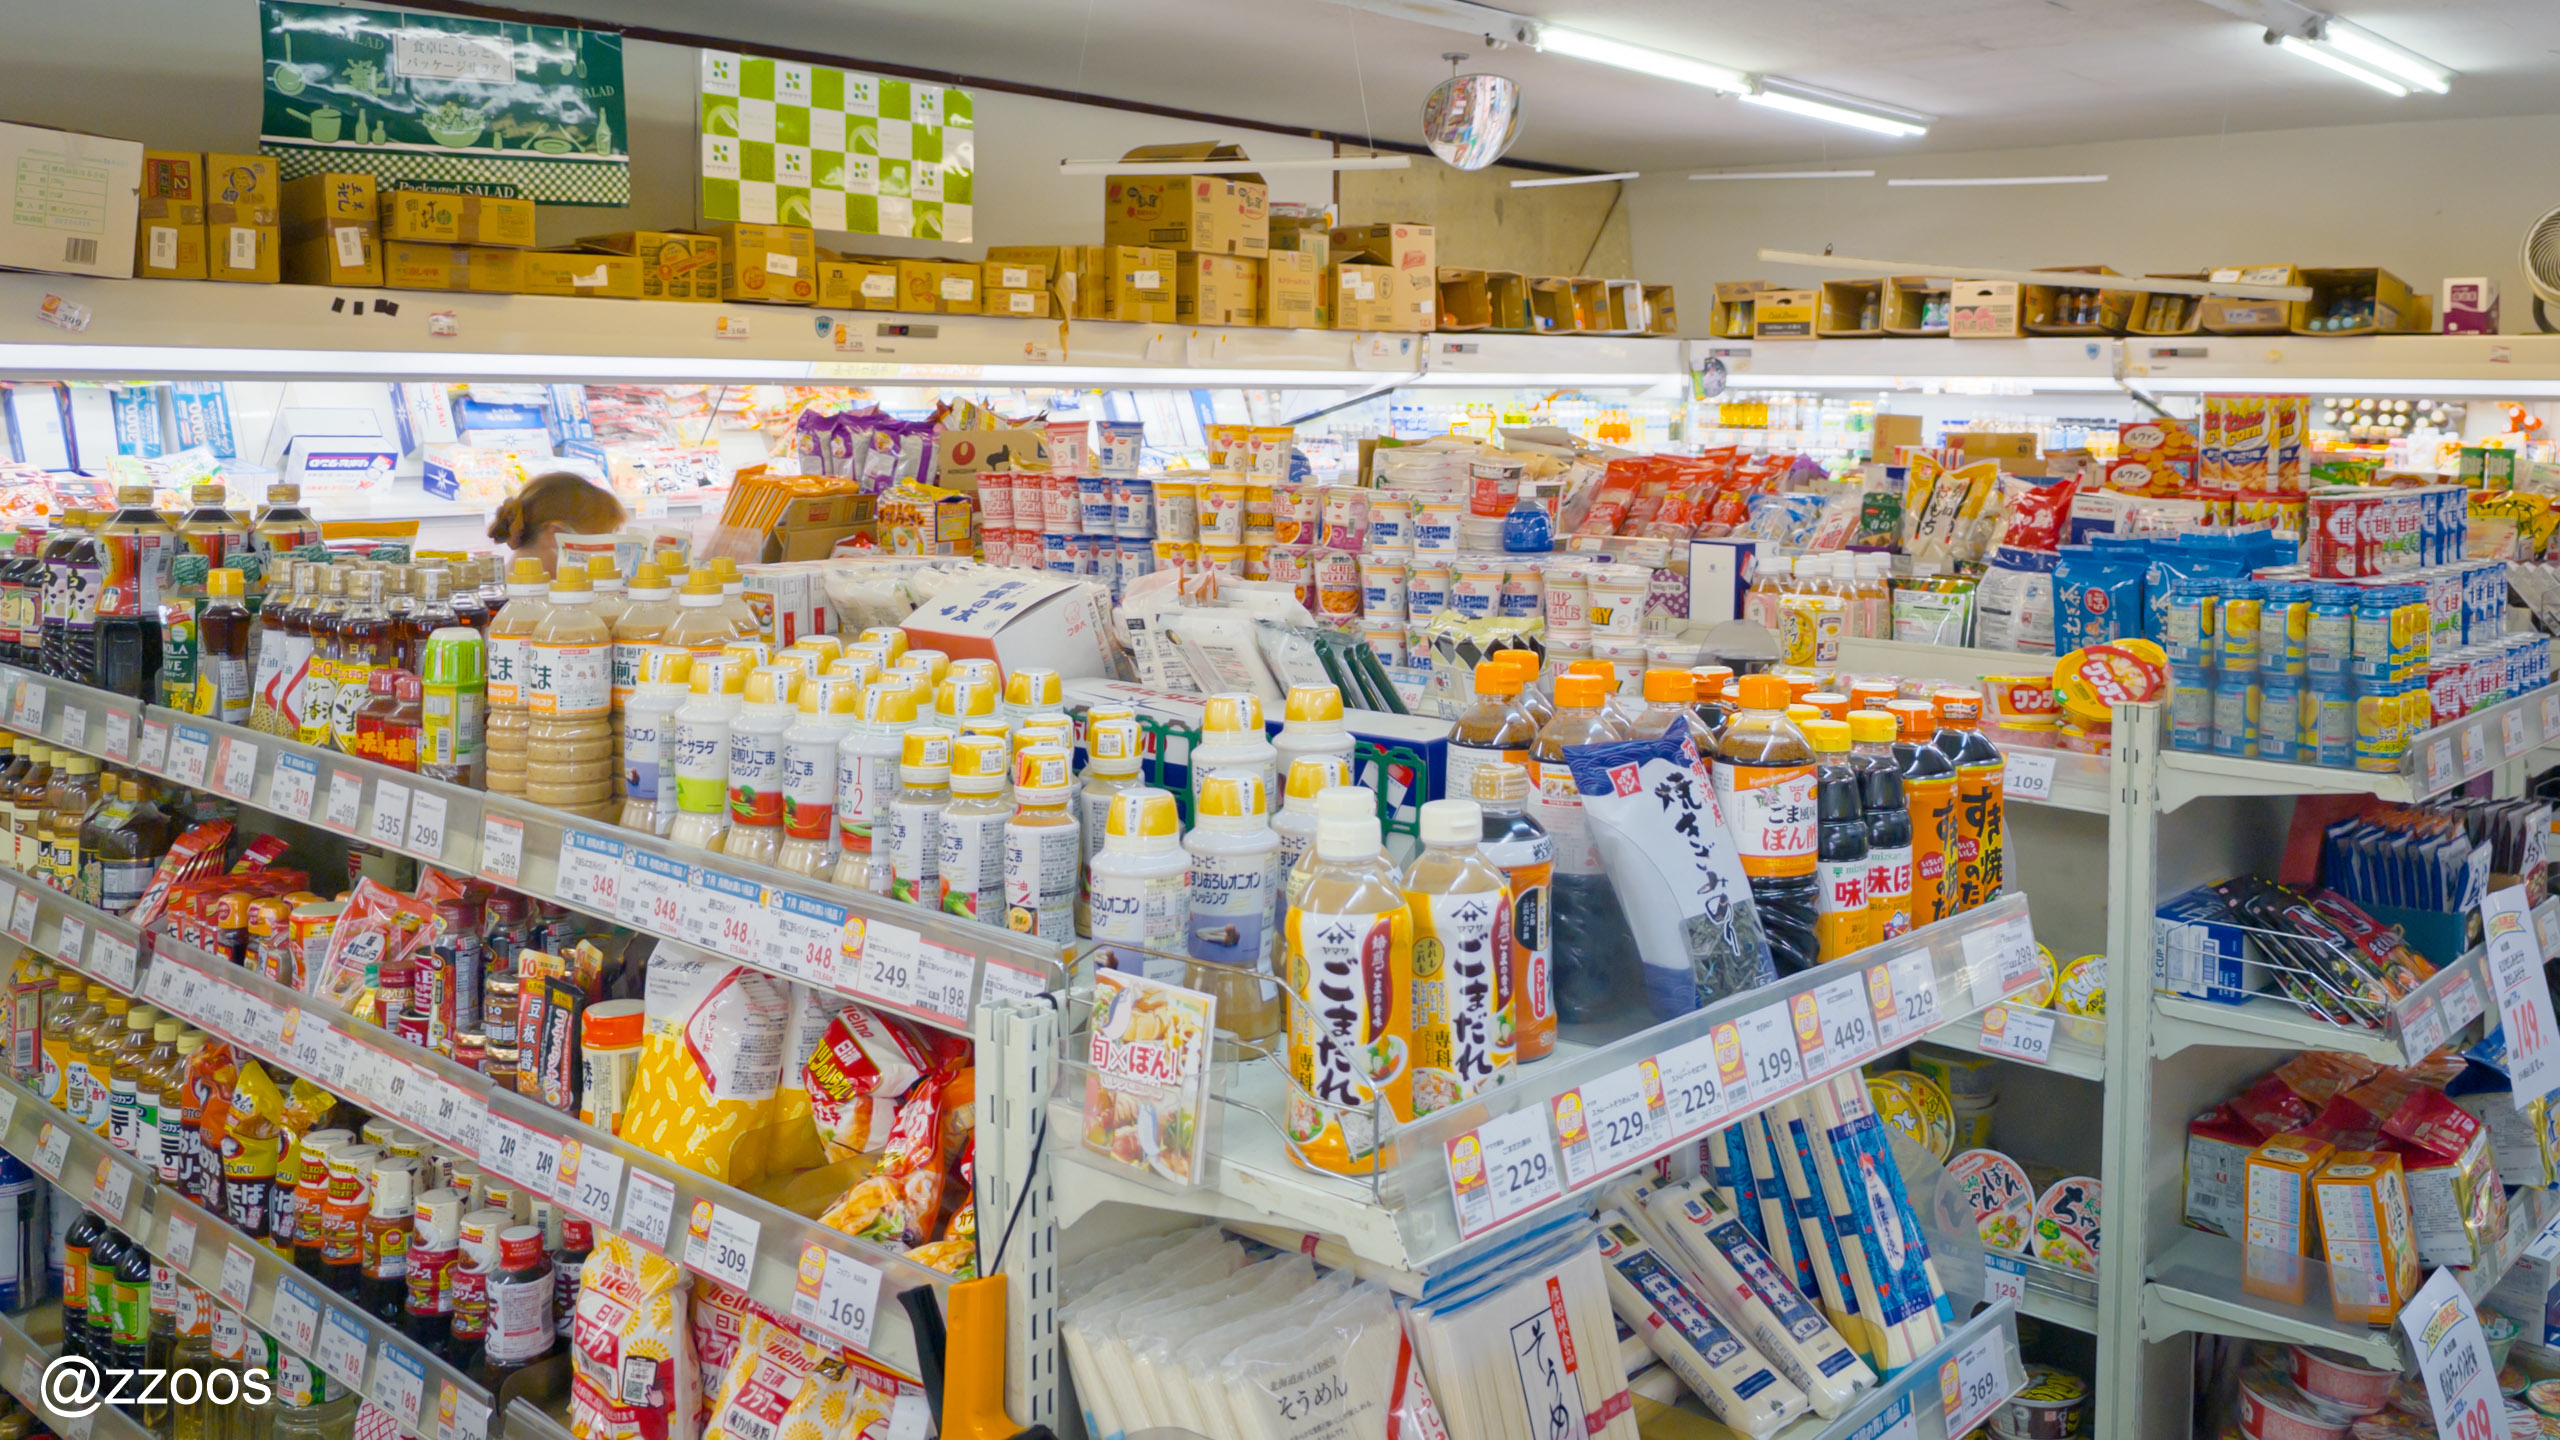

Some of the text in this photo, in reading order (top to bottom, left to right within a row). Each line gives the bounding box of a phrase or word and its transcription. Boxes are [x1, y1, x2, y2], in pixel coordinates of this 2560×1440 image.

[576, 85, 615, 98] SALAD
[465, 184, 516, 199] SALAD
[2012, 774, 2043, 791] 109
[416, 824, 438, 848] 299
[592, 874, 614, 897] 348
[1191, 871, 1261, 889] すりおろしオニオン
[1836, 878, 1868, 908] 味
[654, 897, 677, 921] 348
[723, 918, 748, 943] 348
[1456, 924, 1483, 934] ヤマサ
[806, 942, 833, 970] 348
[1322, 946, 1350, 956] ヤマサ
[520, 957, 538, 977] 10
[873, 961, 907, 989] 249
[942, 984, 965, 1008] 198
[1453, 932, 1493, 1082] ごまだれ
[1904, 989, 1933, 1021] 229
[520, 998, 543, 1072] 豆板醤
[1316, 956, 1361, 1107] ごまだれ
[1834, 1017, 1865, 1050] 449
[2012, 1034, 2043, 1053] 109
[2513, 999, 2540, 1061] 149
[1434, 1030, 1452, 1068] 専科
[1758, 1048, 1793, 1084] 199
[1681, 1079, 1716, 1115] 229
[1607, 1111, 1643, 1148] 229
[499, 1135, 517, 1159] 249
[536, 1151, 553, 1175] 249
[1507, 1152, 1548, 1193] 229
[582, 1183, 611, 1213] 279
[645, 1216, 665, 1238] 219
[716, 1243, 747, 1275] 309
[1995, 1281, 2017, 1299] 129
[829, 1297, 866, 1332] 169
[766, 1340, 814, 1372] Welna
[762, 1366, 787, 1388] 日清
[1969, 1371, 1995, 1407] 369
[741, 1383, 784, 1414] フラワー
[1277, 1373, 1348, 1422] そうめん
